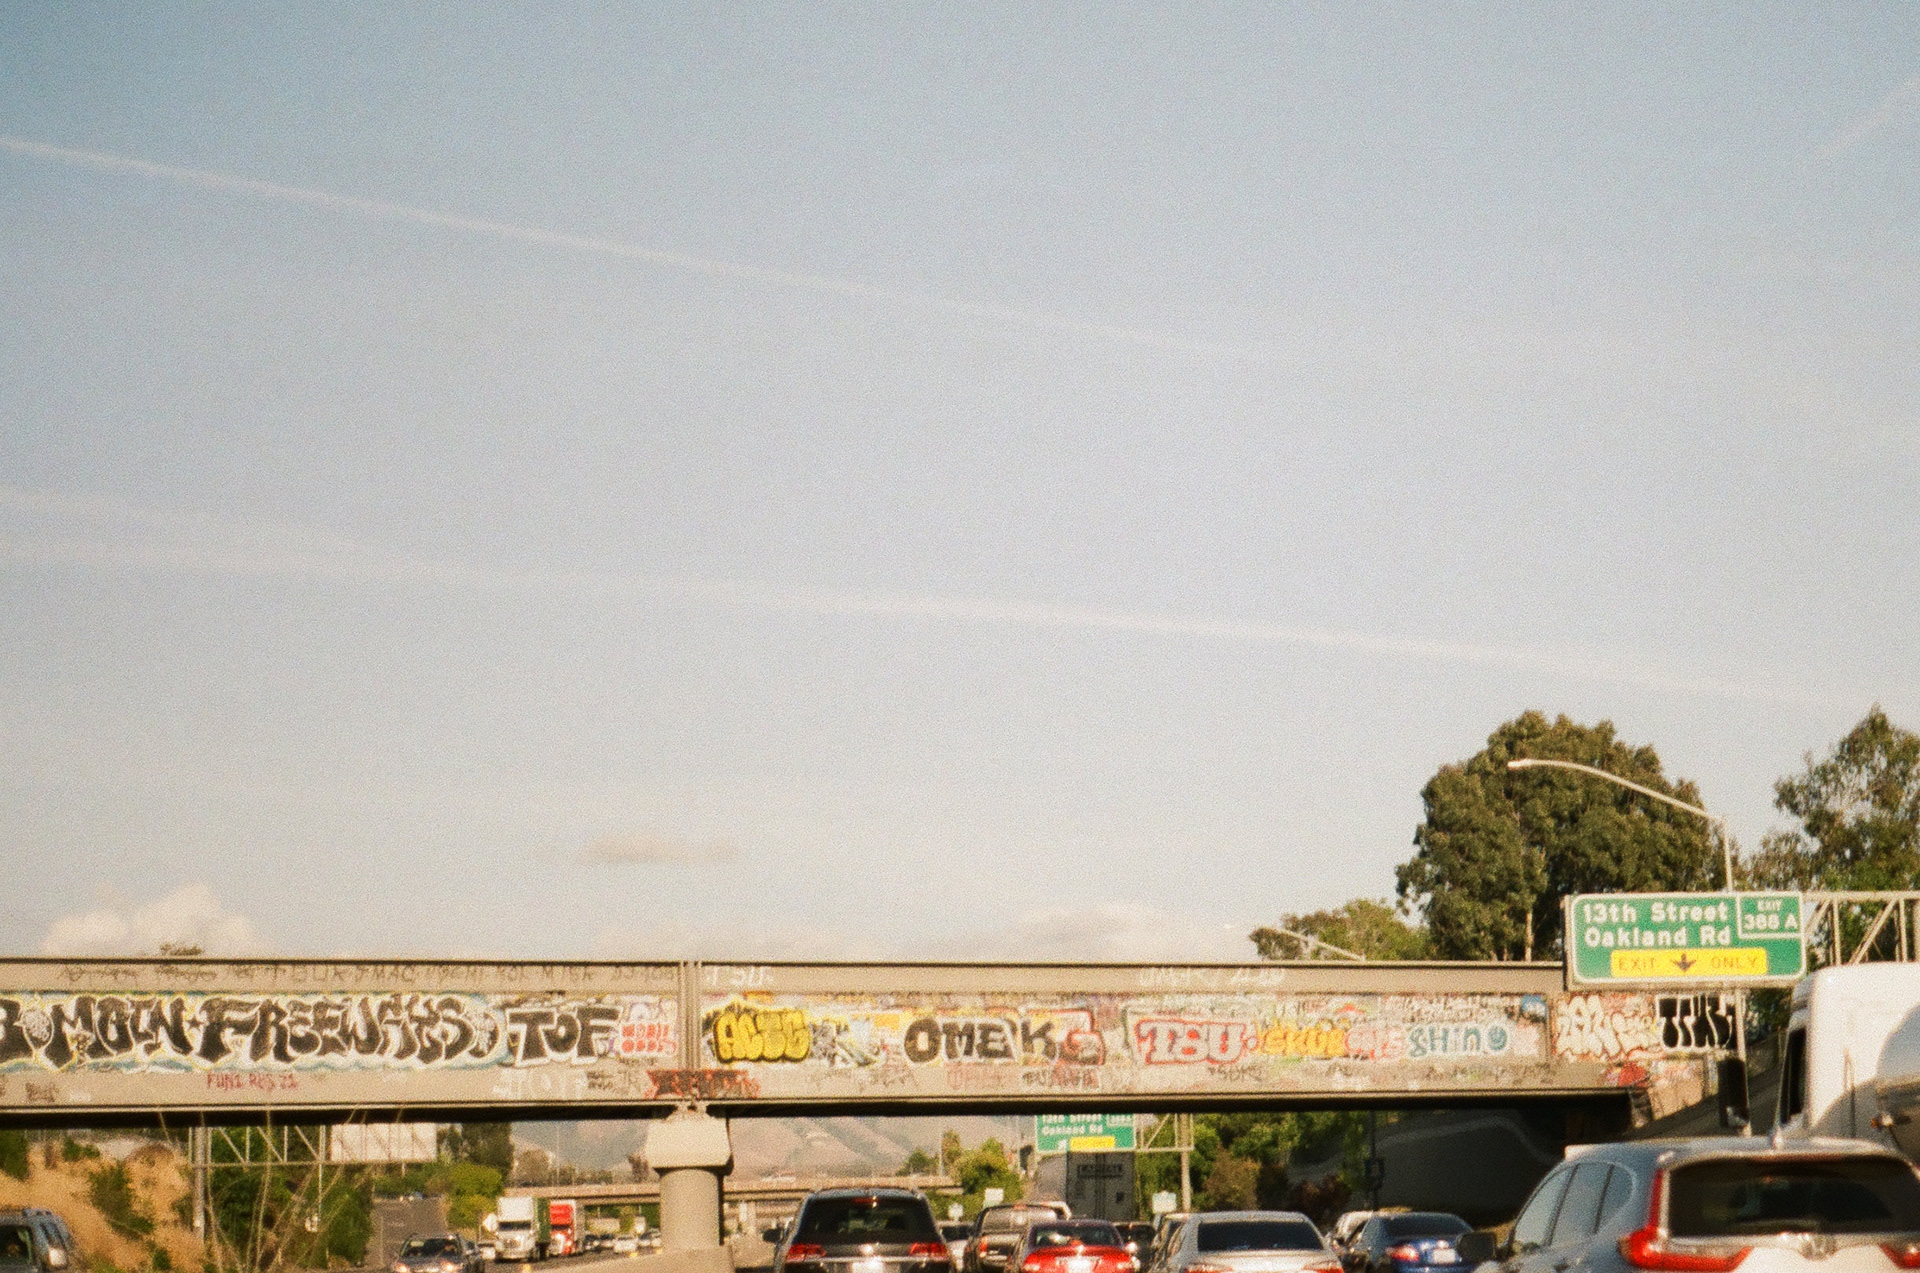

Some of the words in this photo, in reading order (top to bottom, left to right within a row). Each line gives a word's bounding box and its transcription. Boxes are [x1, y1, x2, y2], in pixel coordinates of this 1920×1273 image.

[1583, 903, 1637, 923] 13th
[1651, 901, 1729, 923] Street
[1744, 913, 1780, 930] 388
[1784, 912, 1799, 929] A
[1584, 926, 1688, 948] Oakland
[1700, 924, 1732, 946] Rd
[1618, 956, 1656, 972] EXIT
[1711, 954, 1757, 970] ONLY
